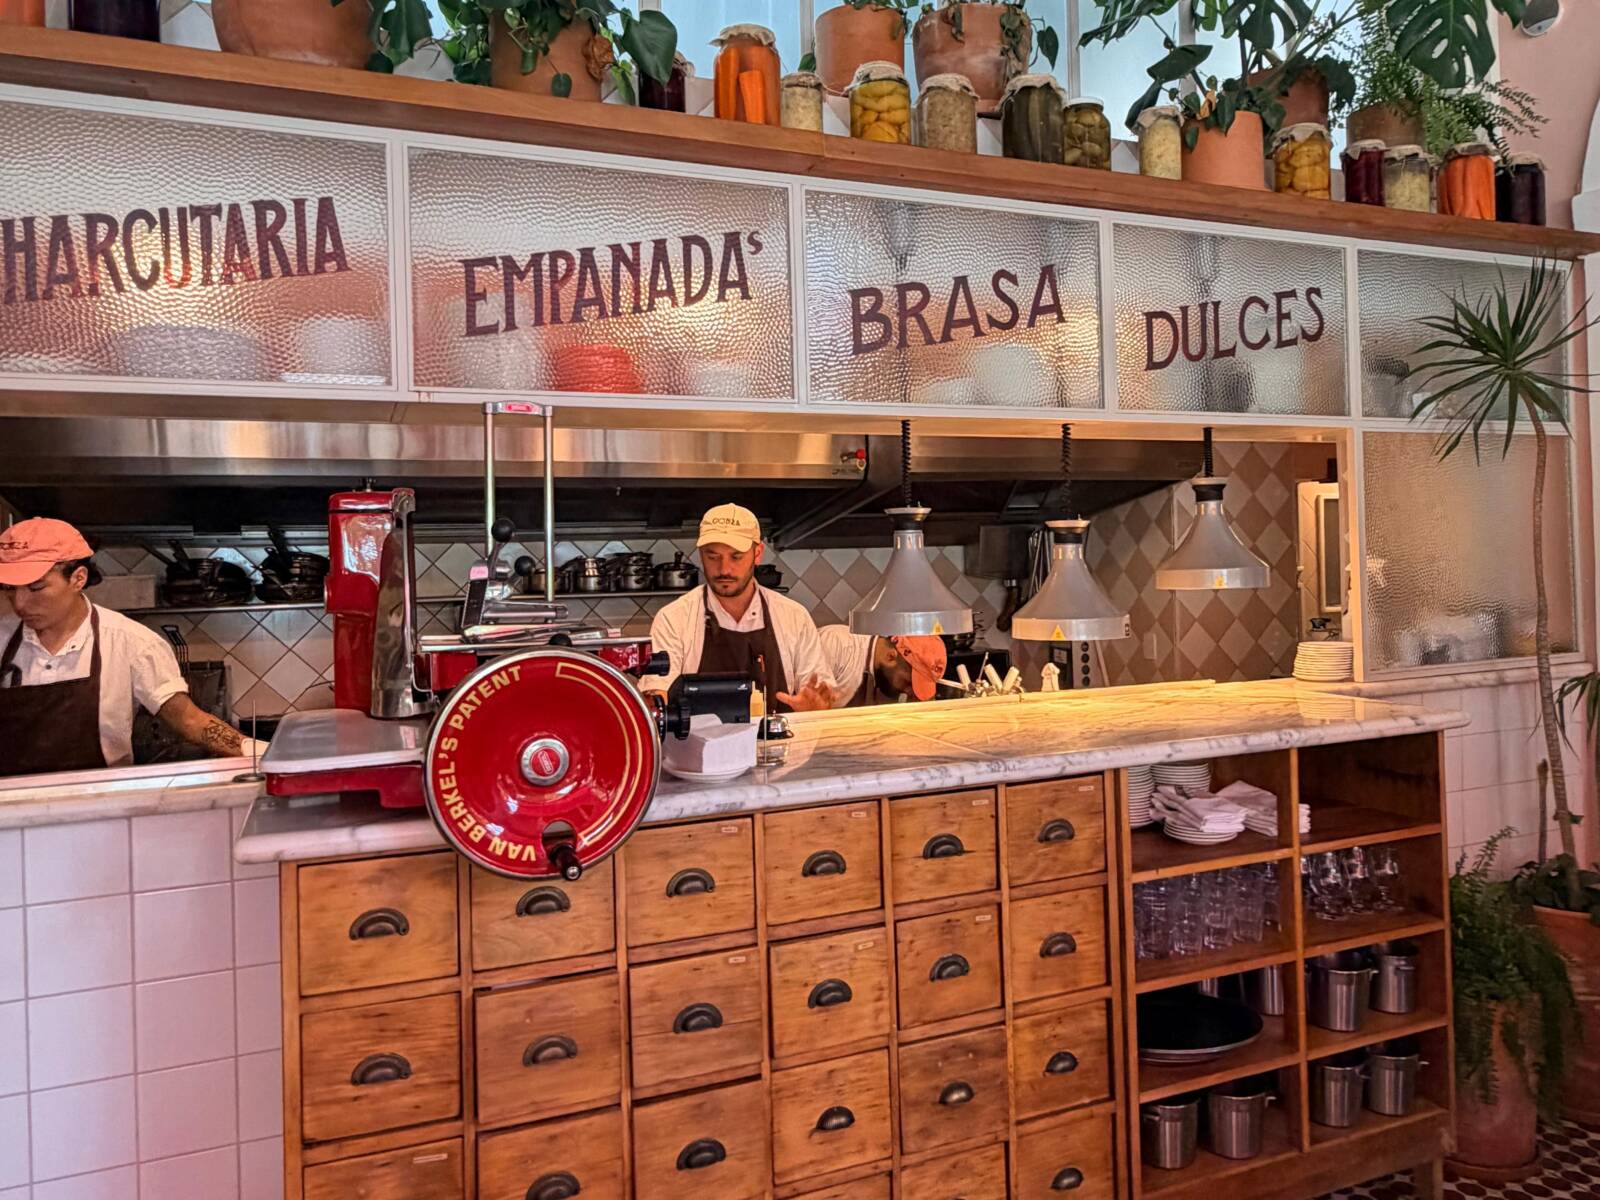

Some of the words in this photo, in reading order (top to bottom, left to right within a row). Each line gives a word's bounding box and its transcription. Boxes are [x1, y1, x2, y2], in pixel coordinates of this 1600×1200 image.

[0, 197, 352, 304] HARCUTARIA
[850, 264, 1066, 356] BRASA
[1142, 286, 1325, 372] DULCES
[449, 665, 521, 731] PATENT
[487, 838, 537, 862] VAN
